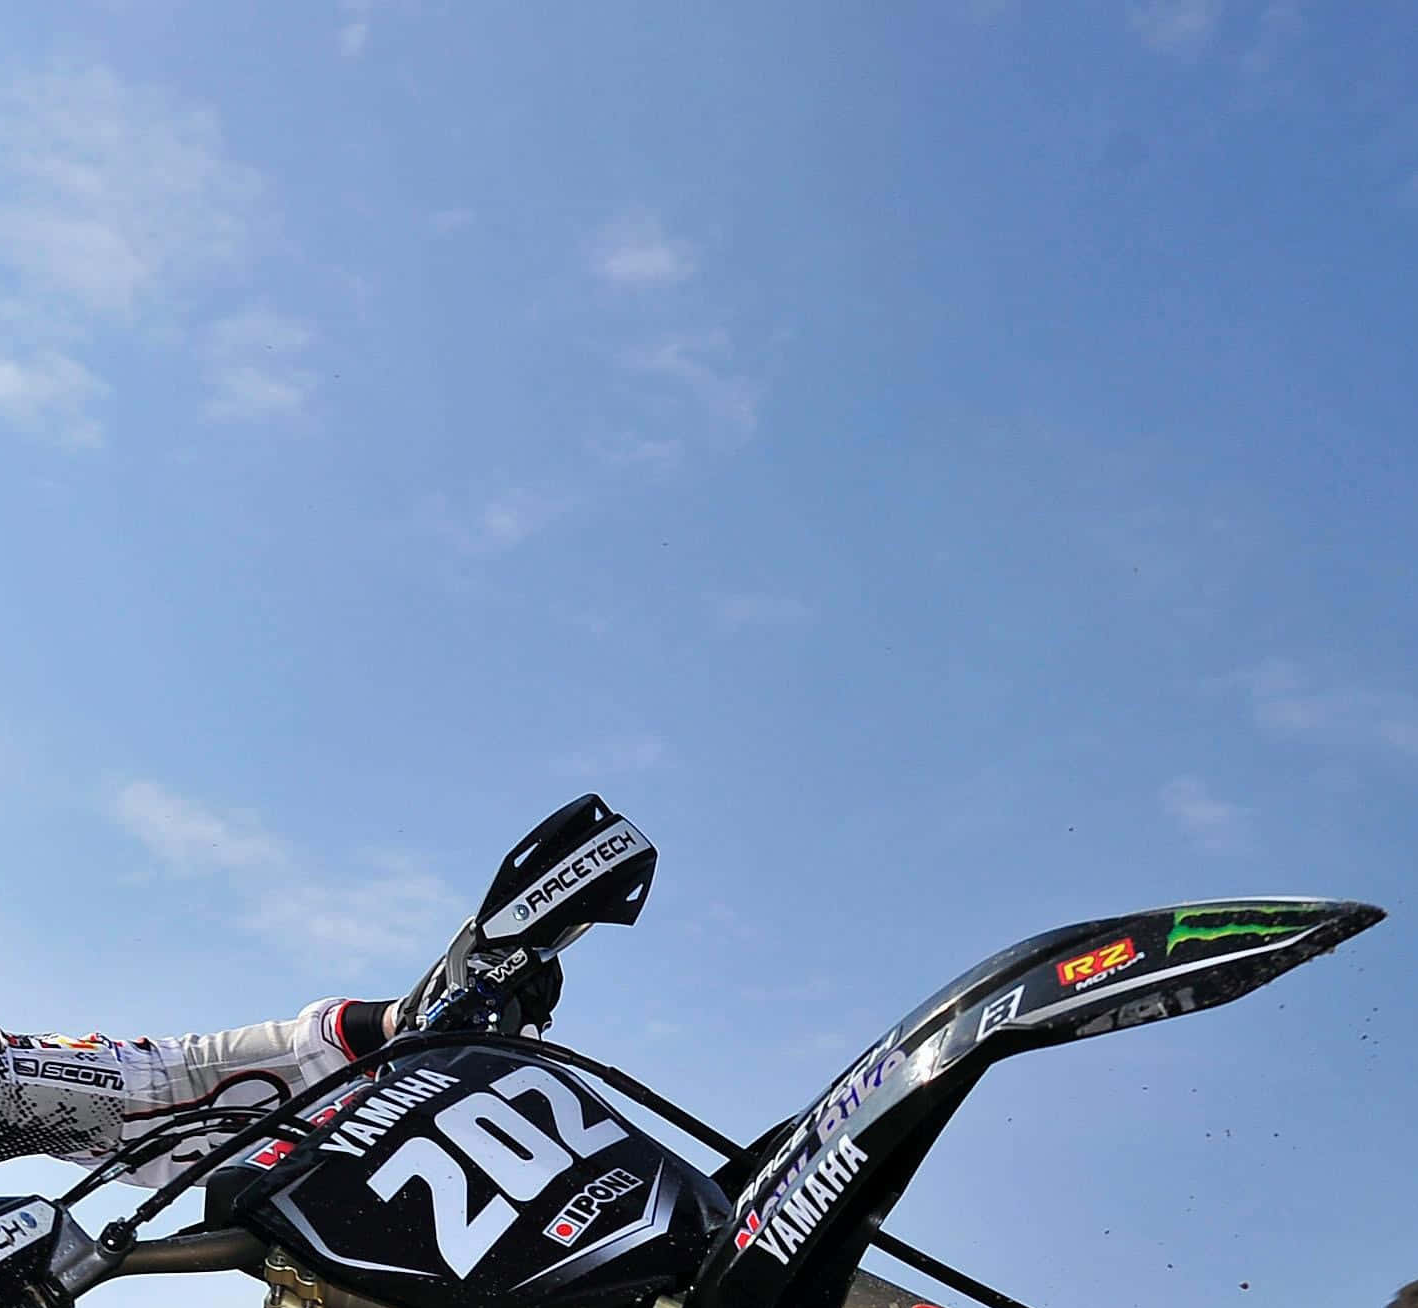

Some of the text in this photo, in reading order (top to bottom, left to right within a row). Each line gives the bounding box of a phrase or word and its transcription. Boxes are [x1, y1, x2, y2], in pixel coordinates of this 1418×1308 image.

[525, 831, 637, 913] RACETECH
[1062, 943, 1130, 981] RZ
[43, 1063, 124, 1089] SCOTT
[319, 1069, 461, 1158] YAMAHA
[735, 1024, 904, 1219] RACETECH
[366, 1065, 630, 1281] 202
[563, 1168, 643, 1226] IPONE
[755, 1133, 869, 1265] YAMAHA
